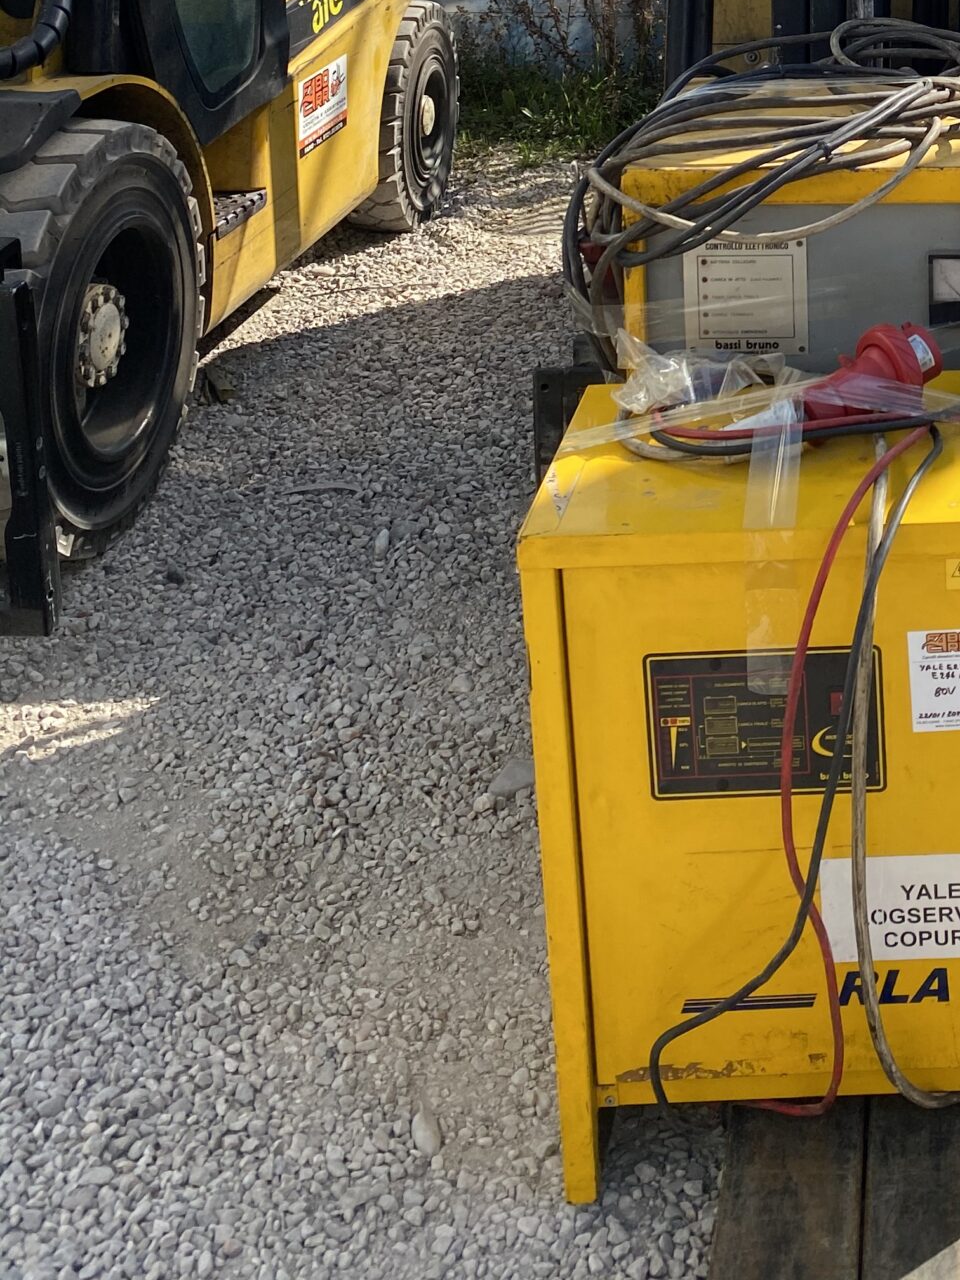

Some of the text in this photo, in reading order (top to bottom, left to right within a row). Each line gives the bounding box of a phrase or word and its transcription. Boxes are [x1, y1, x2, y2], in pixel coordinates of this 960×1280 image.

[705, 240, 789, 250] CONTROLLO ELETTRONICO
[715, 339, 780, 350] bassi bruno
[920, 663, 944, 671] YALE
